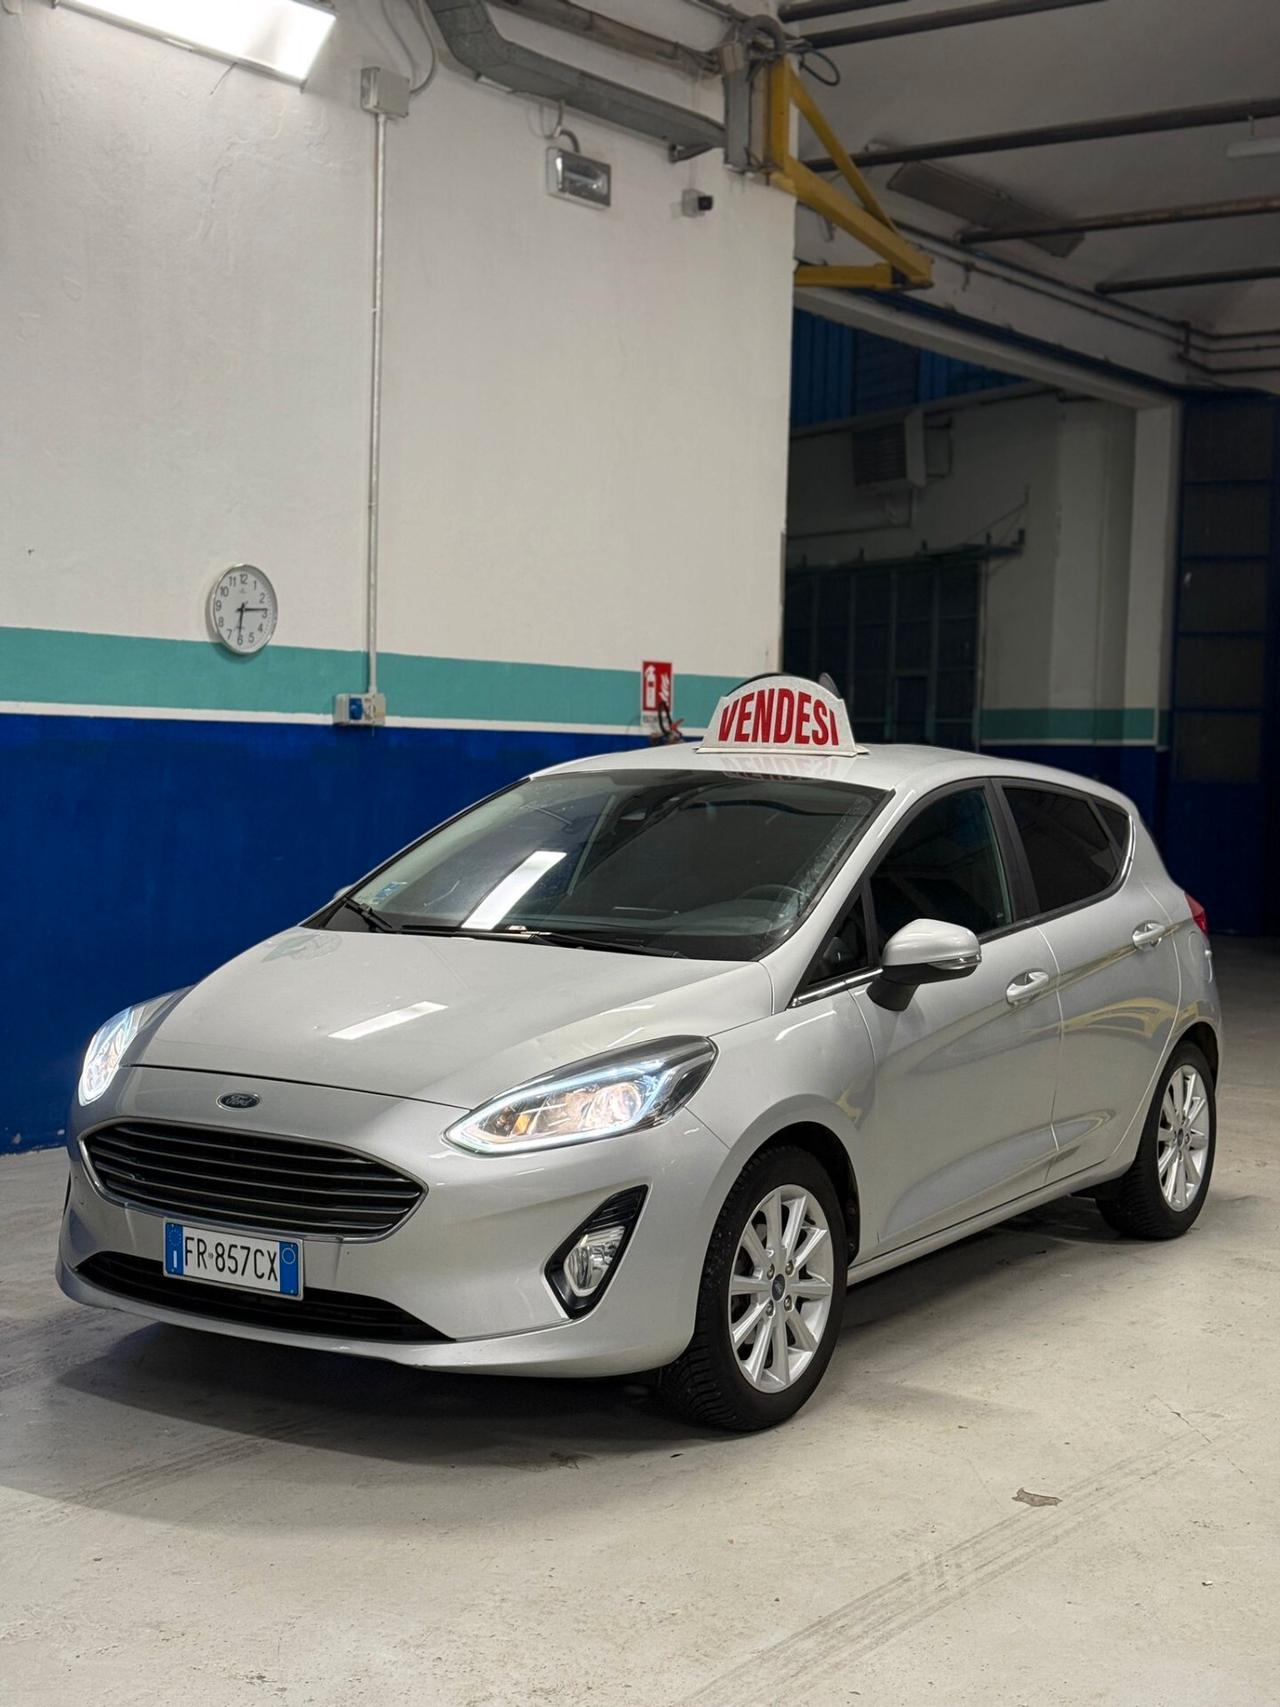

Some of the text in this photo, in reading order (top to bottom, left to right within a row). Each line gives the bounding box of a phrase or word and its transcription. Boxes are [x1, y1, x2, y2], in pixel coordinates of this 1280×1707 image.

[229, 576, 236, 587] 11
[240, 574, 248, 584] 12
[253, 580, 257, 591] 1
[220, 586, 229, 597] 10
[259, 592, 266, 604] 2
[215, 600, 222, 612] 9
[262, 608, 268, 619] 3
[218, 616, 225, 628] 8
[257, 623, 263, 632] 4
[226, 628, 233, 640] 7
[248, 632, 255, 643] 5
[237, 634, 243, 646] 6
[718, 688, 839, 746] VENDESI
[172, 1250, 178, 1269] I
